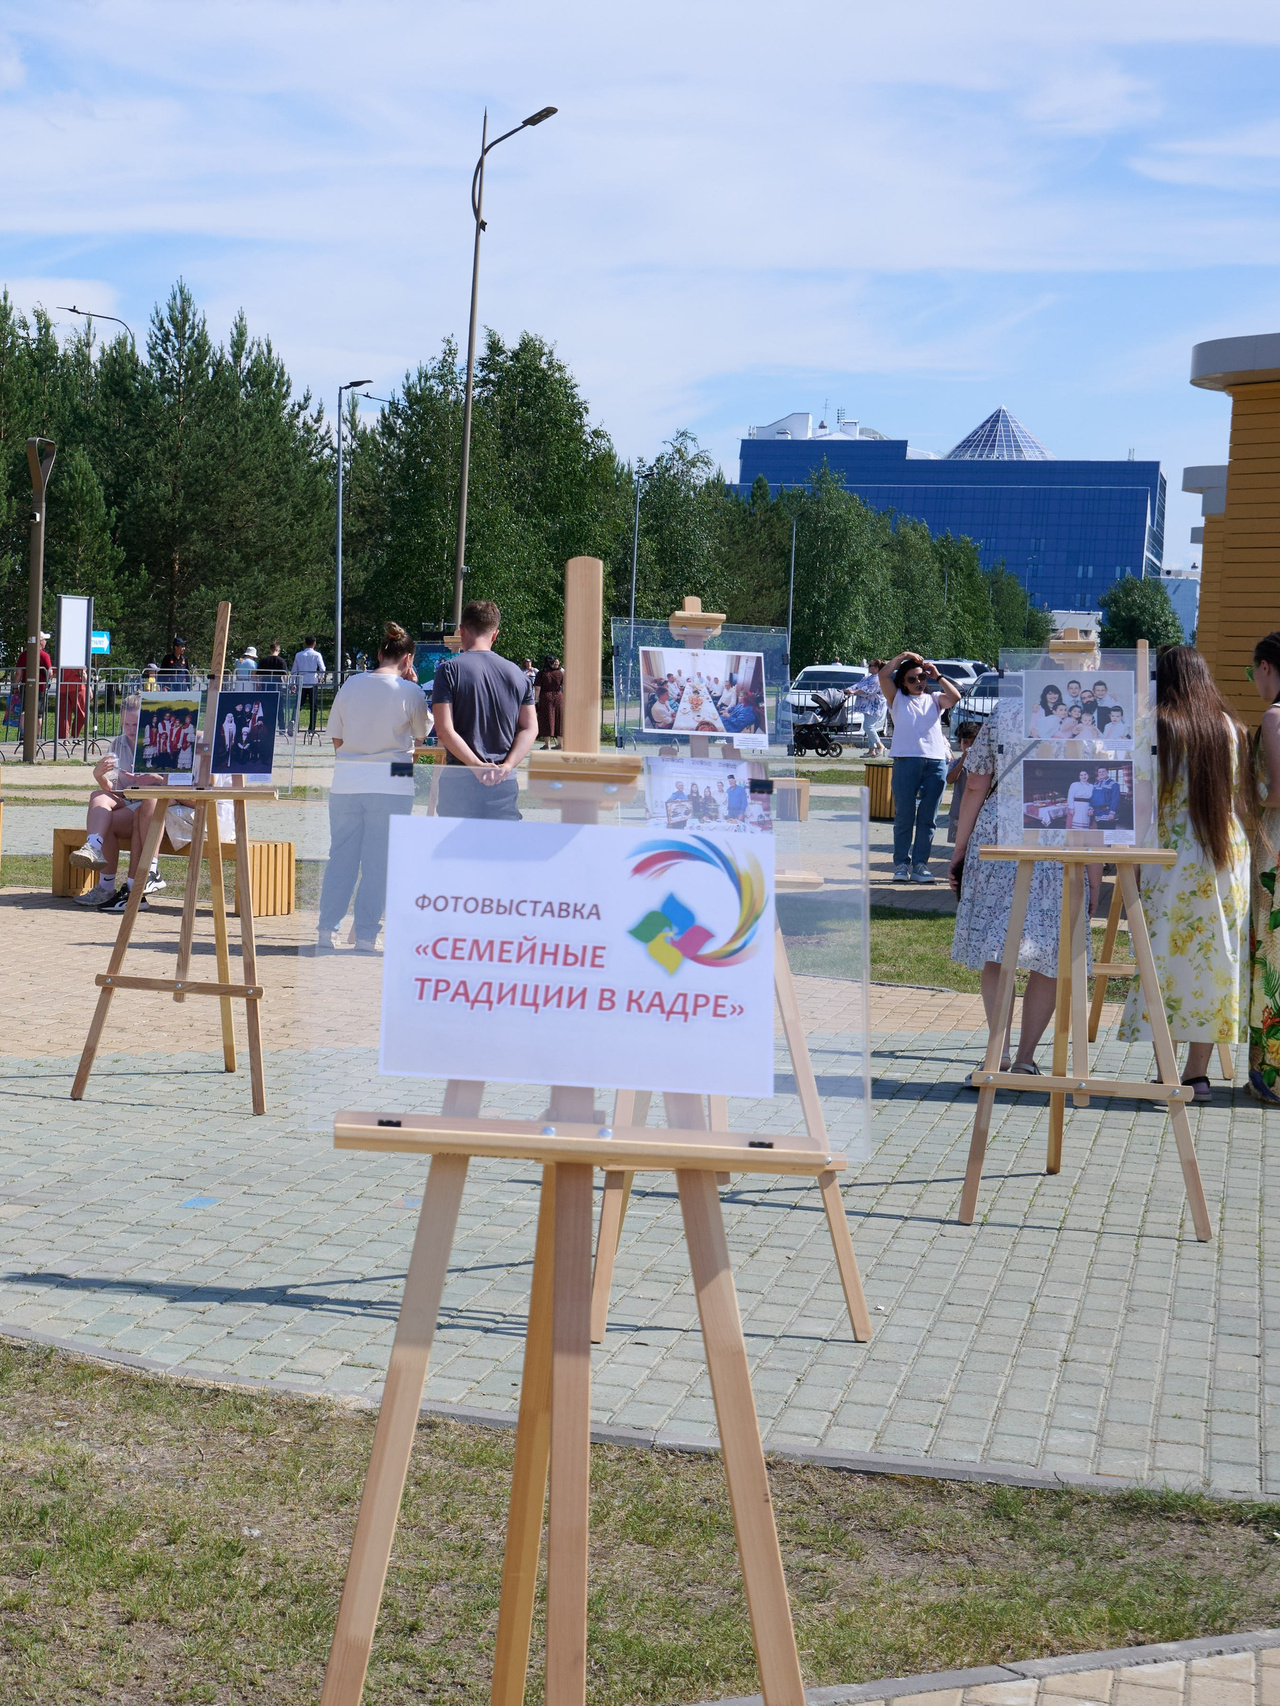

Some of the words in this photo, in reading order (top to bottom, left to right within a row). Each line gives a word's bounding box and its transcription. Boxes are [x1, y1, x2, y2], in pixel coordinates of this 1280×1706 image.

[414, 894, 601, 921] ФОТОВЫСТАВКА
[414, 934, 607, 969] «СЕМЕЙНЫЕ
[414, 977, 588, 1014] ТРАДИЦИИ
[597, 988, 616, 1011] В
[626, 989, 744, 1023] КАДРЕ»
